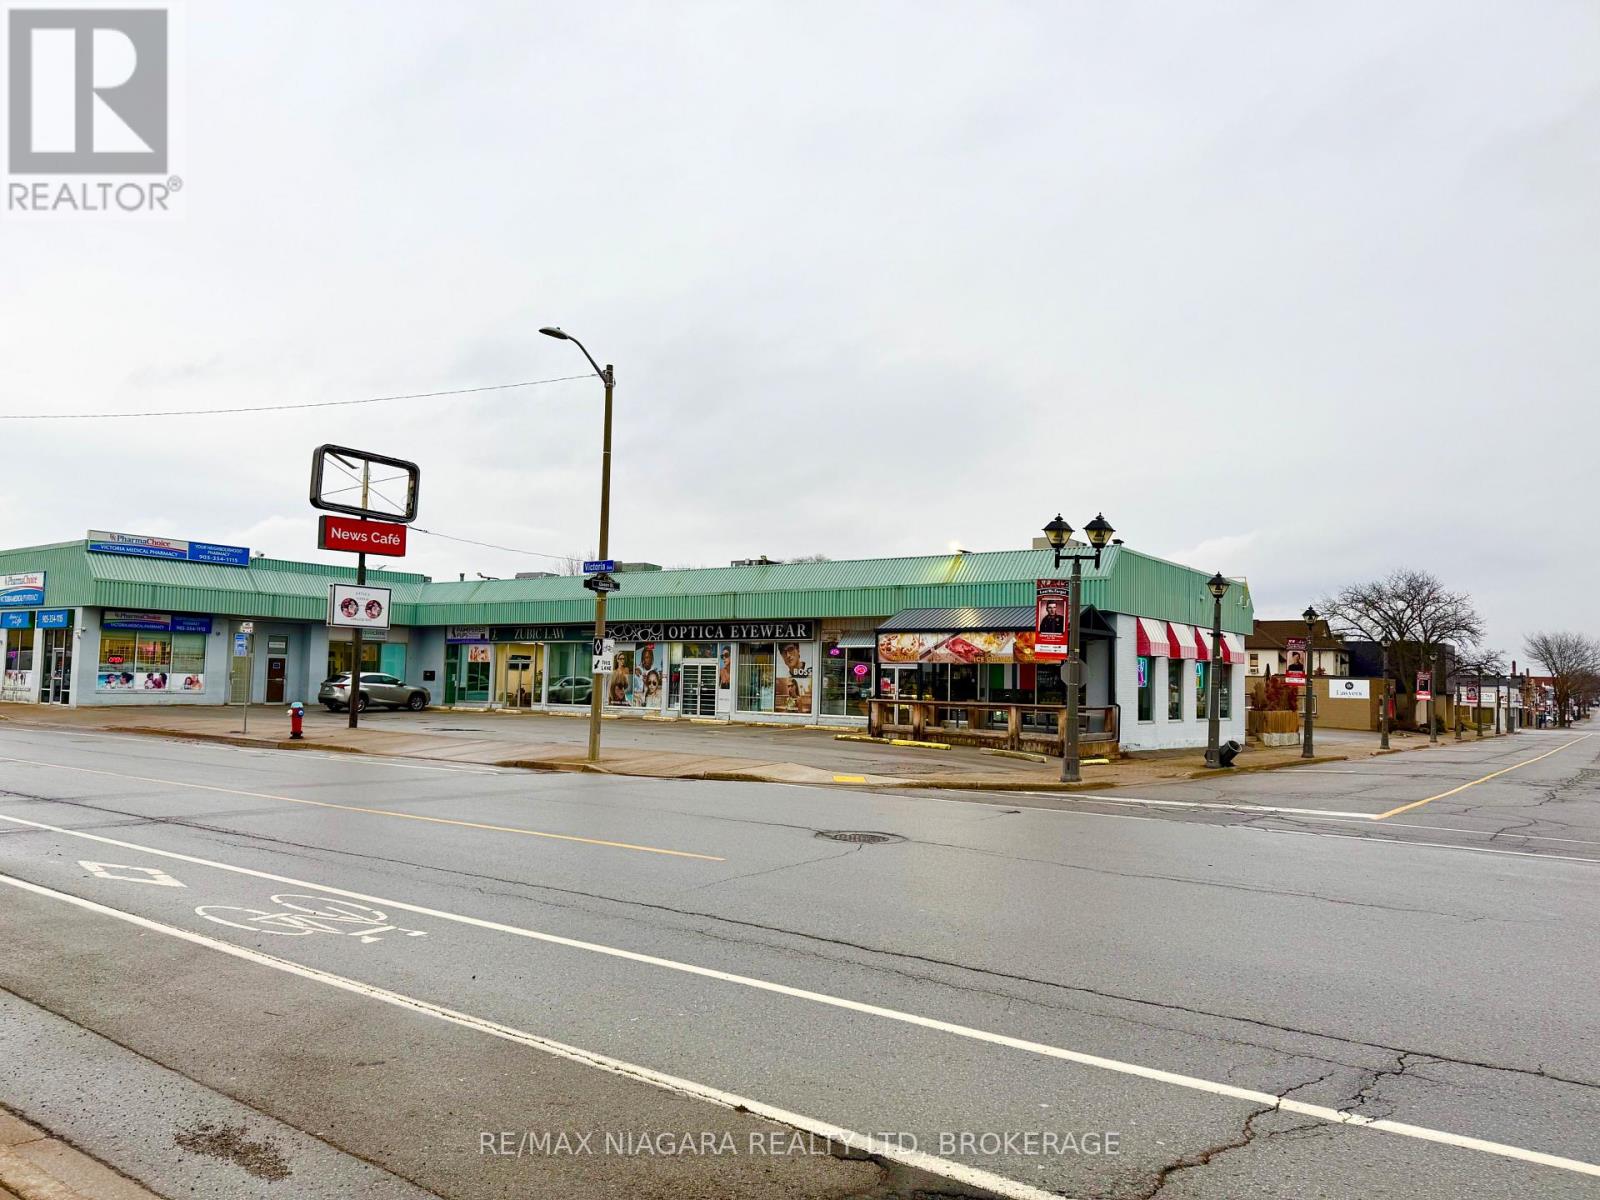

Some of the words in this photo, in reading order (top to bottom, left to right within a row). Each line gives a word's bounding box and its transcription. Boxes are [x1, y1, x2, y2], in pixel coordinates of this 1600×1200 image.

[117, 534, 171, 547] PharmaChoice
[331, 527, 368, 542] News
[371, 532, 400, 545] Café
[585, 562, 605, 571] Victoria
[515, 627, 542, 639] ZUBIC
[544, 627, 565, 639] LAW
[668, 625, 724, 639] OPTICA
[730, 623, 807, 638] EYEWEAR
[108, 656, 123, 664] OPEN
[793, 667, 813, 676] BOSS
